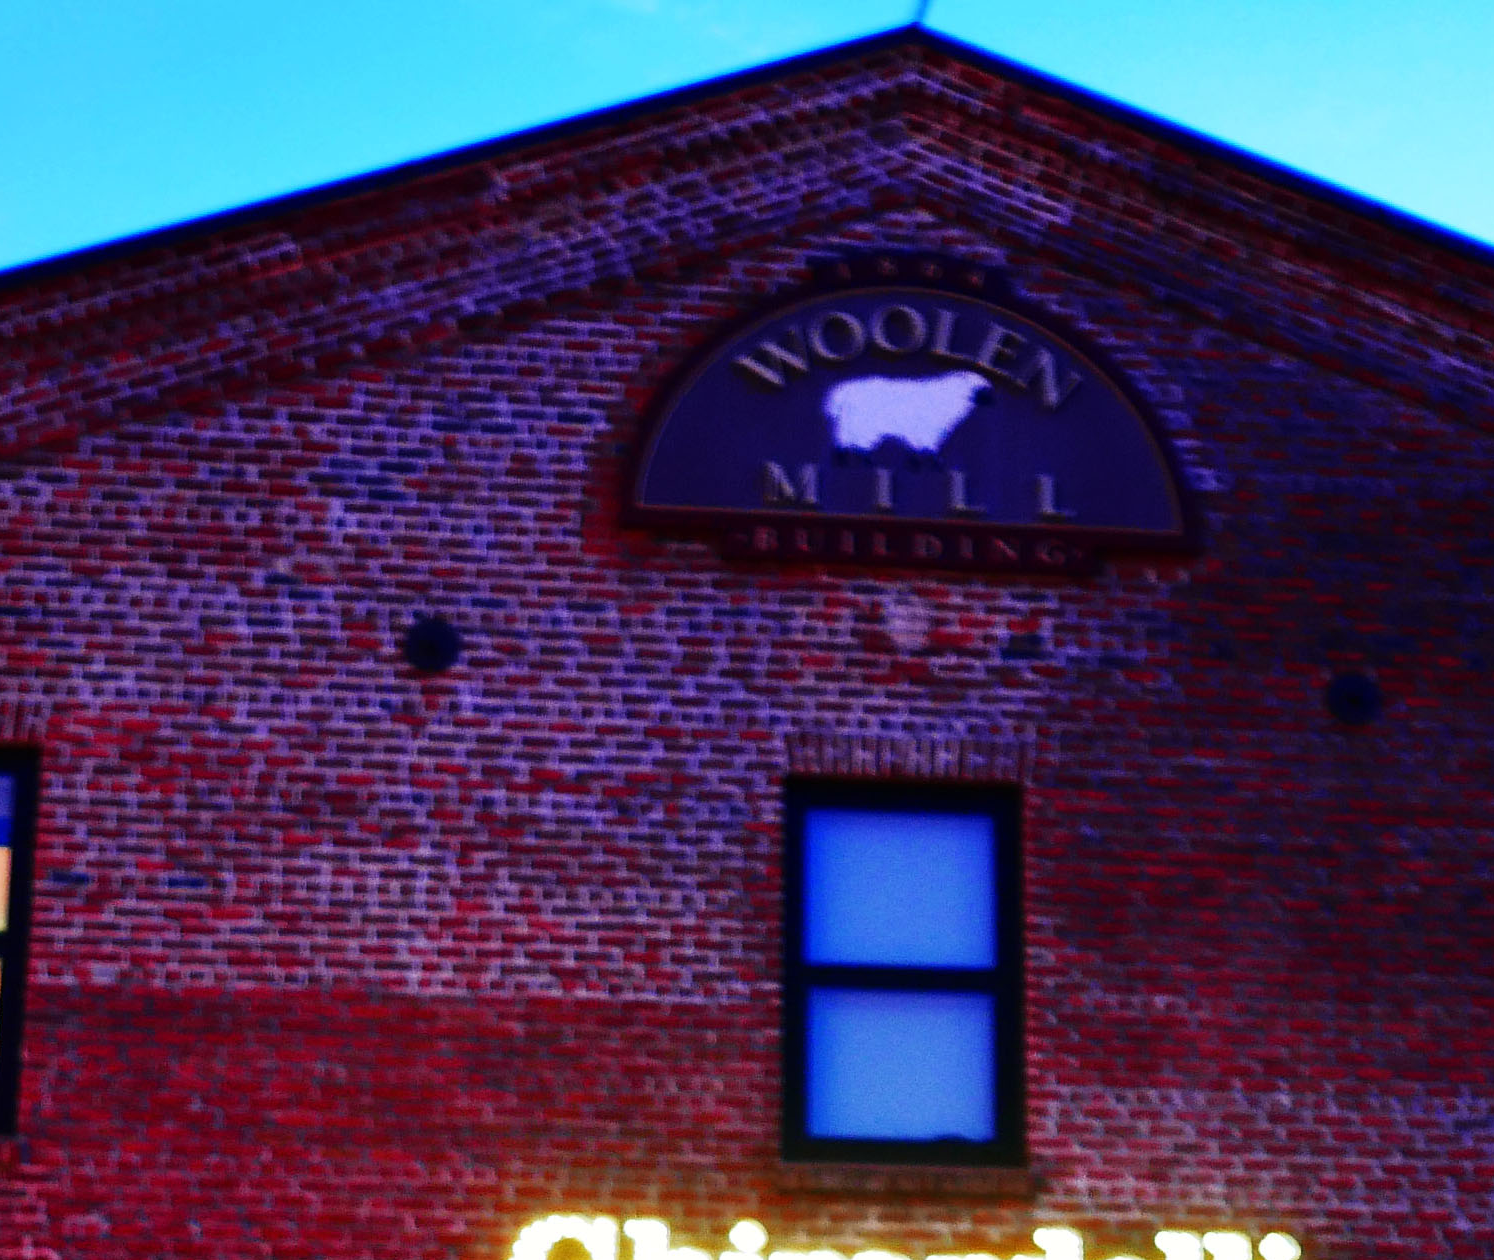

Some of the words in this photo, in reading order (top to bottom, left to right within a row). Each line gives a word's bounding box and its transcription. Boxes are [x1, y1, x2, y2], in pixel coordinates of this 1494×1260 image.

[731, 303, 1083, 408] WOOLEN
[763, 461, 1076, 517] MILL
[751, 524, 1067, 567] BUILDING
